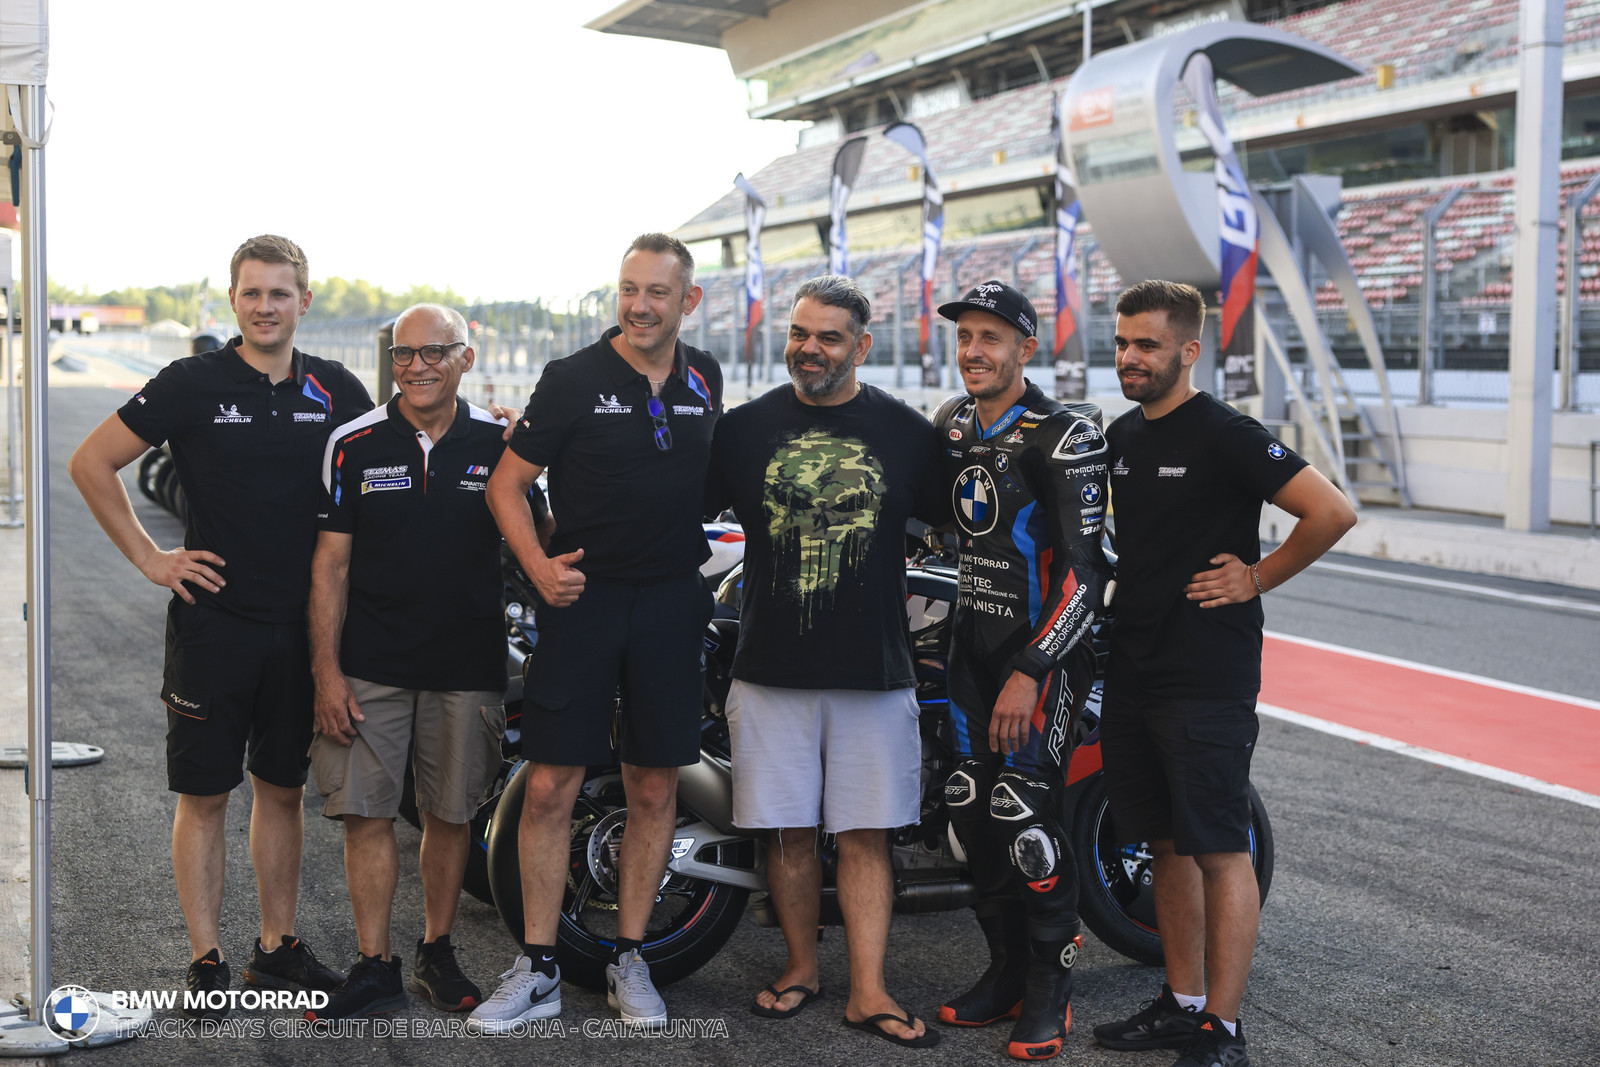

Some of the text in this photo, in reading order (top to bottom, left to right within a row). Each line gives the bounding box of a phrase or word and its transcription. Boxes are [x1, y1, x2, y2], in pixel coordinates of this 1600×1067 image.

[1063, 430, 1101, 450] RST
[960, 469, 992, 491] BMW
[988, 589, 1008, 598] ENGINE
[1038, 584, 1087, 651] BMW MOTORRAD
[1045, 601, 1087, 656] MOTORSPORT
[1048, 668, 1073, 767] RST
